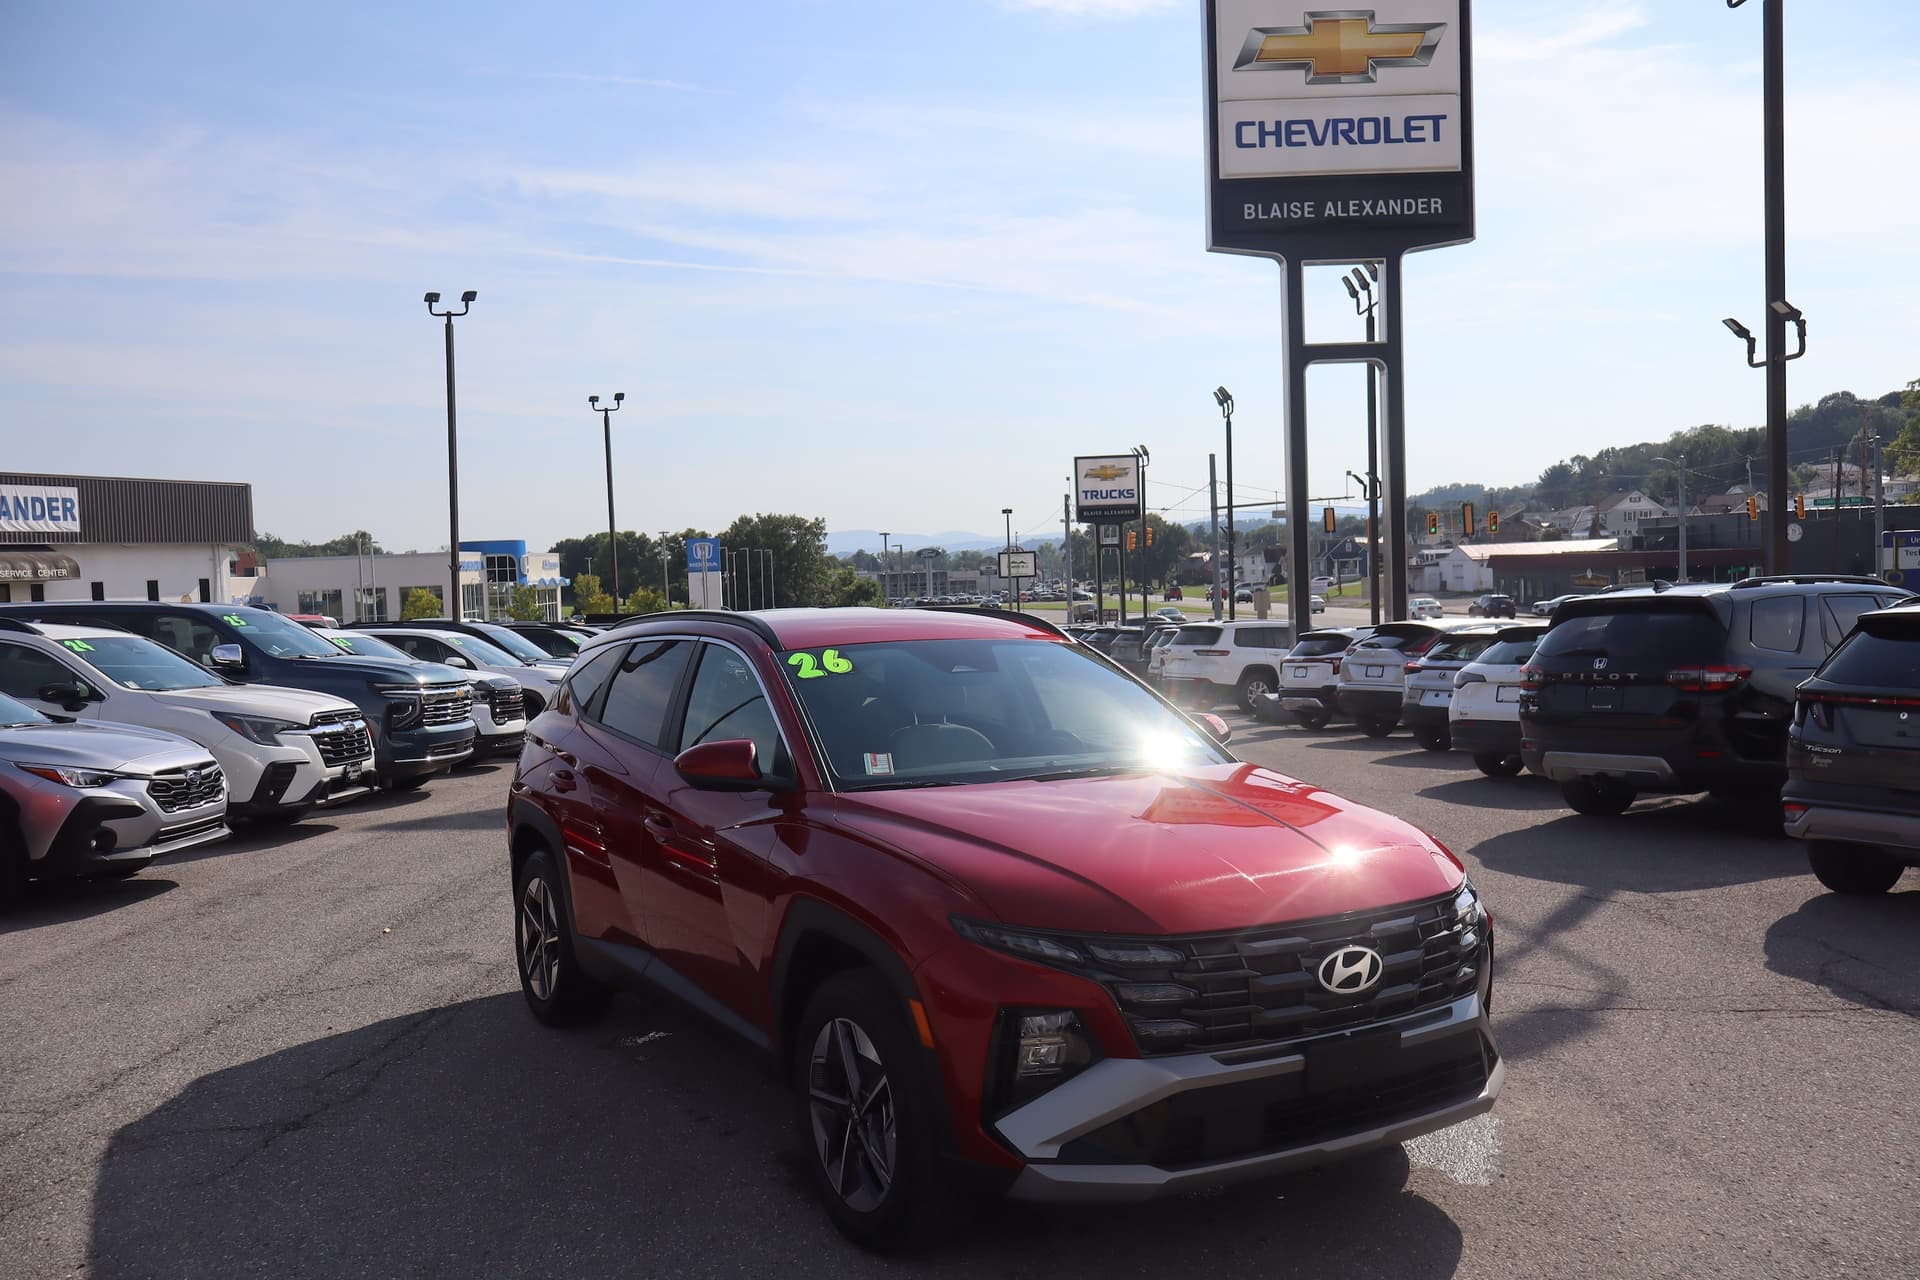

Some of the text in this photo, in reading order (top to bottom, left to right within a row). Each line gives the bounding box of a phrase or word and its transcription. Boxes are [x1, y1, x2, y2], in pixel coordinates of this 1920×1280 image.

[1235, 114, 1447, 148] CHEVROLET
[1243, 198, 1443, 220] BLAISE ALEXANDER
[1082, 489, 1135, 500] TRUCKS
[0, 568, 68, 578] SERVICE CENTER
[64, 639, 96, 652] 24
[787, 649, 853, 679] 26
[1562, 672, 1638, 680] PILOT
